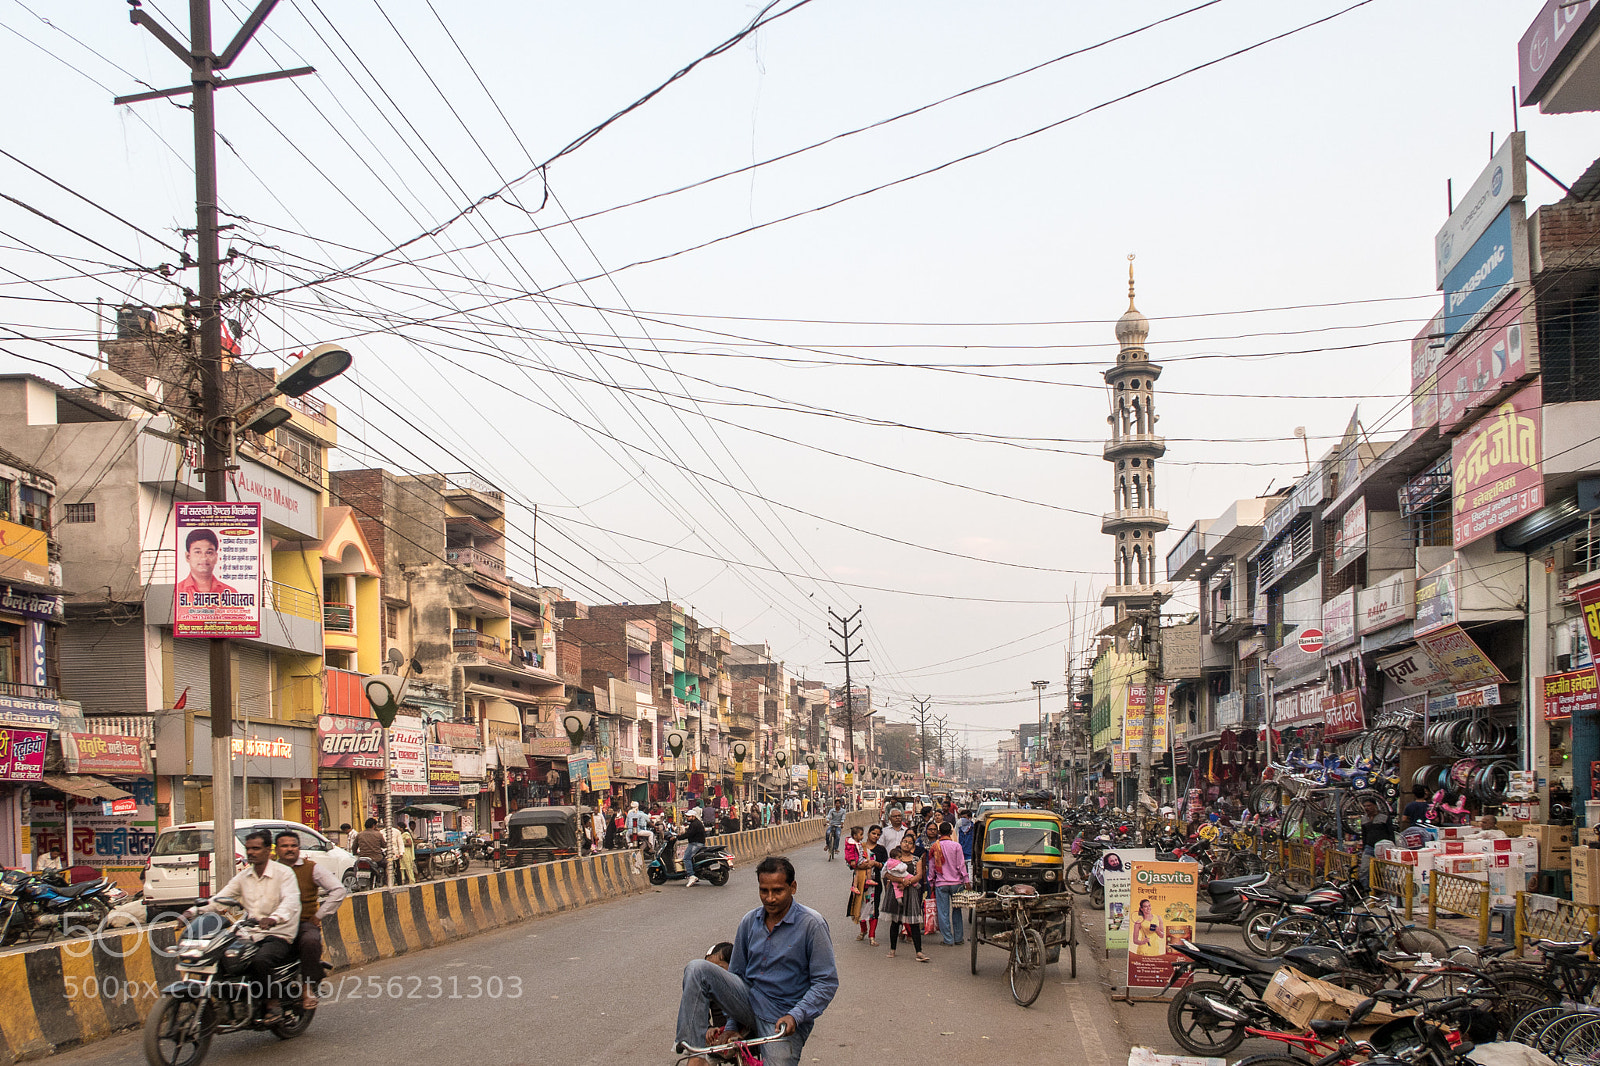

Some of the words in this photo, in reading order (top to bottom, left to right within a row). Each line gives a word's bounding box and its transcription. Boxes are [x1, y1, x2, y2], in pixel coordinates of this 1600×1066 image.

[1450, 245, 1505, 313] Panasonic
[1453, 402, 1538, 513] इन्द्रजीत
[193, 592, 219, 606] आनन्द
[221, 590, 254, 606] श्रीवास्तव
[1385, 656, 1418, 684] पूजा
[1545, 677, 1570, 697] इन्द्रजीत
[1325, 699, 1343, 726] बर्तन
[1343, 701, 1359, 723] घर
[77, 737, 107, 757] संतुष्टि
[322, 728, 382, 754] बालाजी
[1137, 871, 1193, 885] Ojasvita
